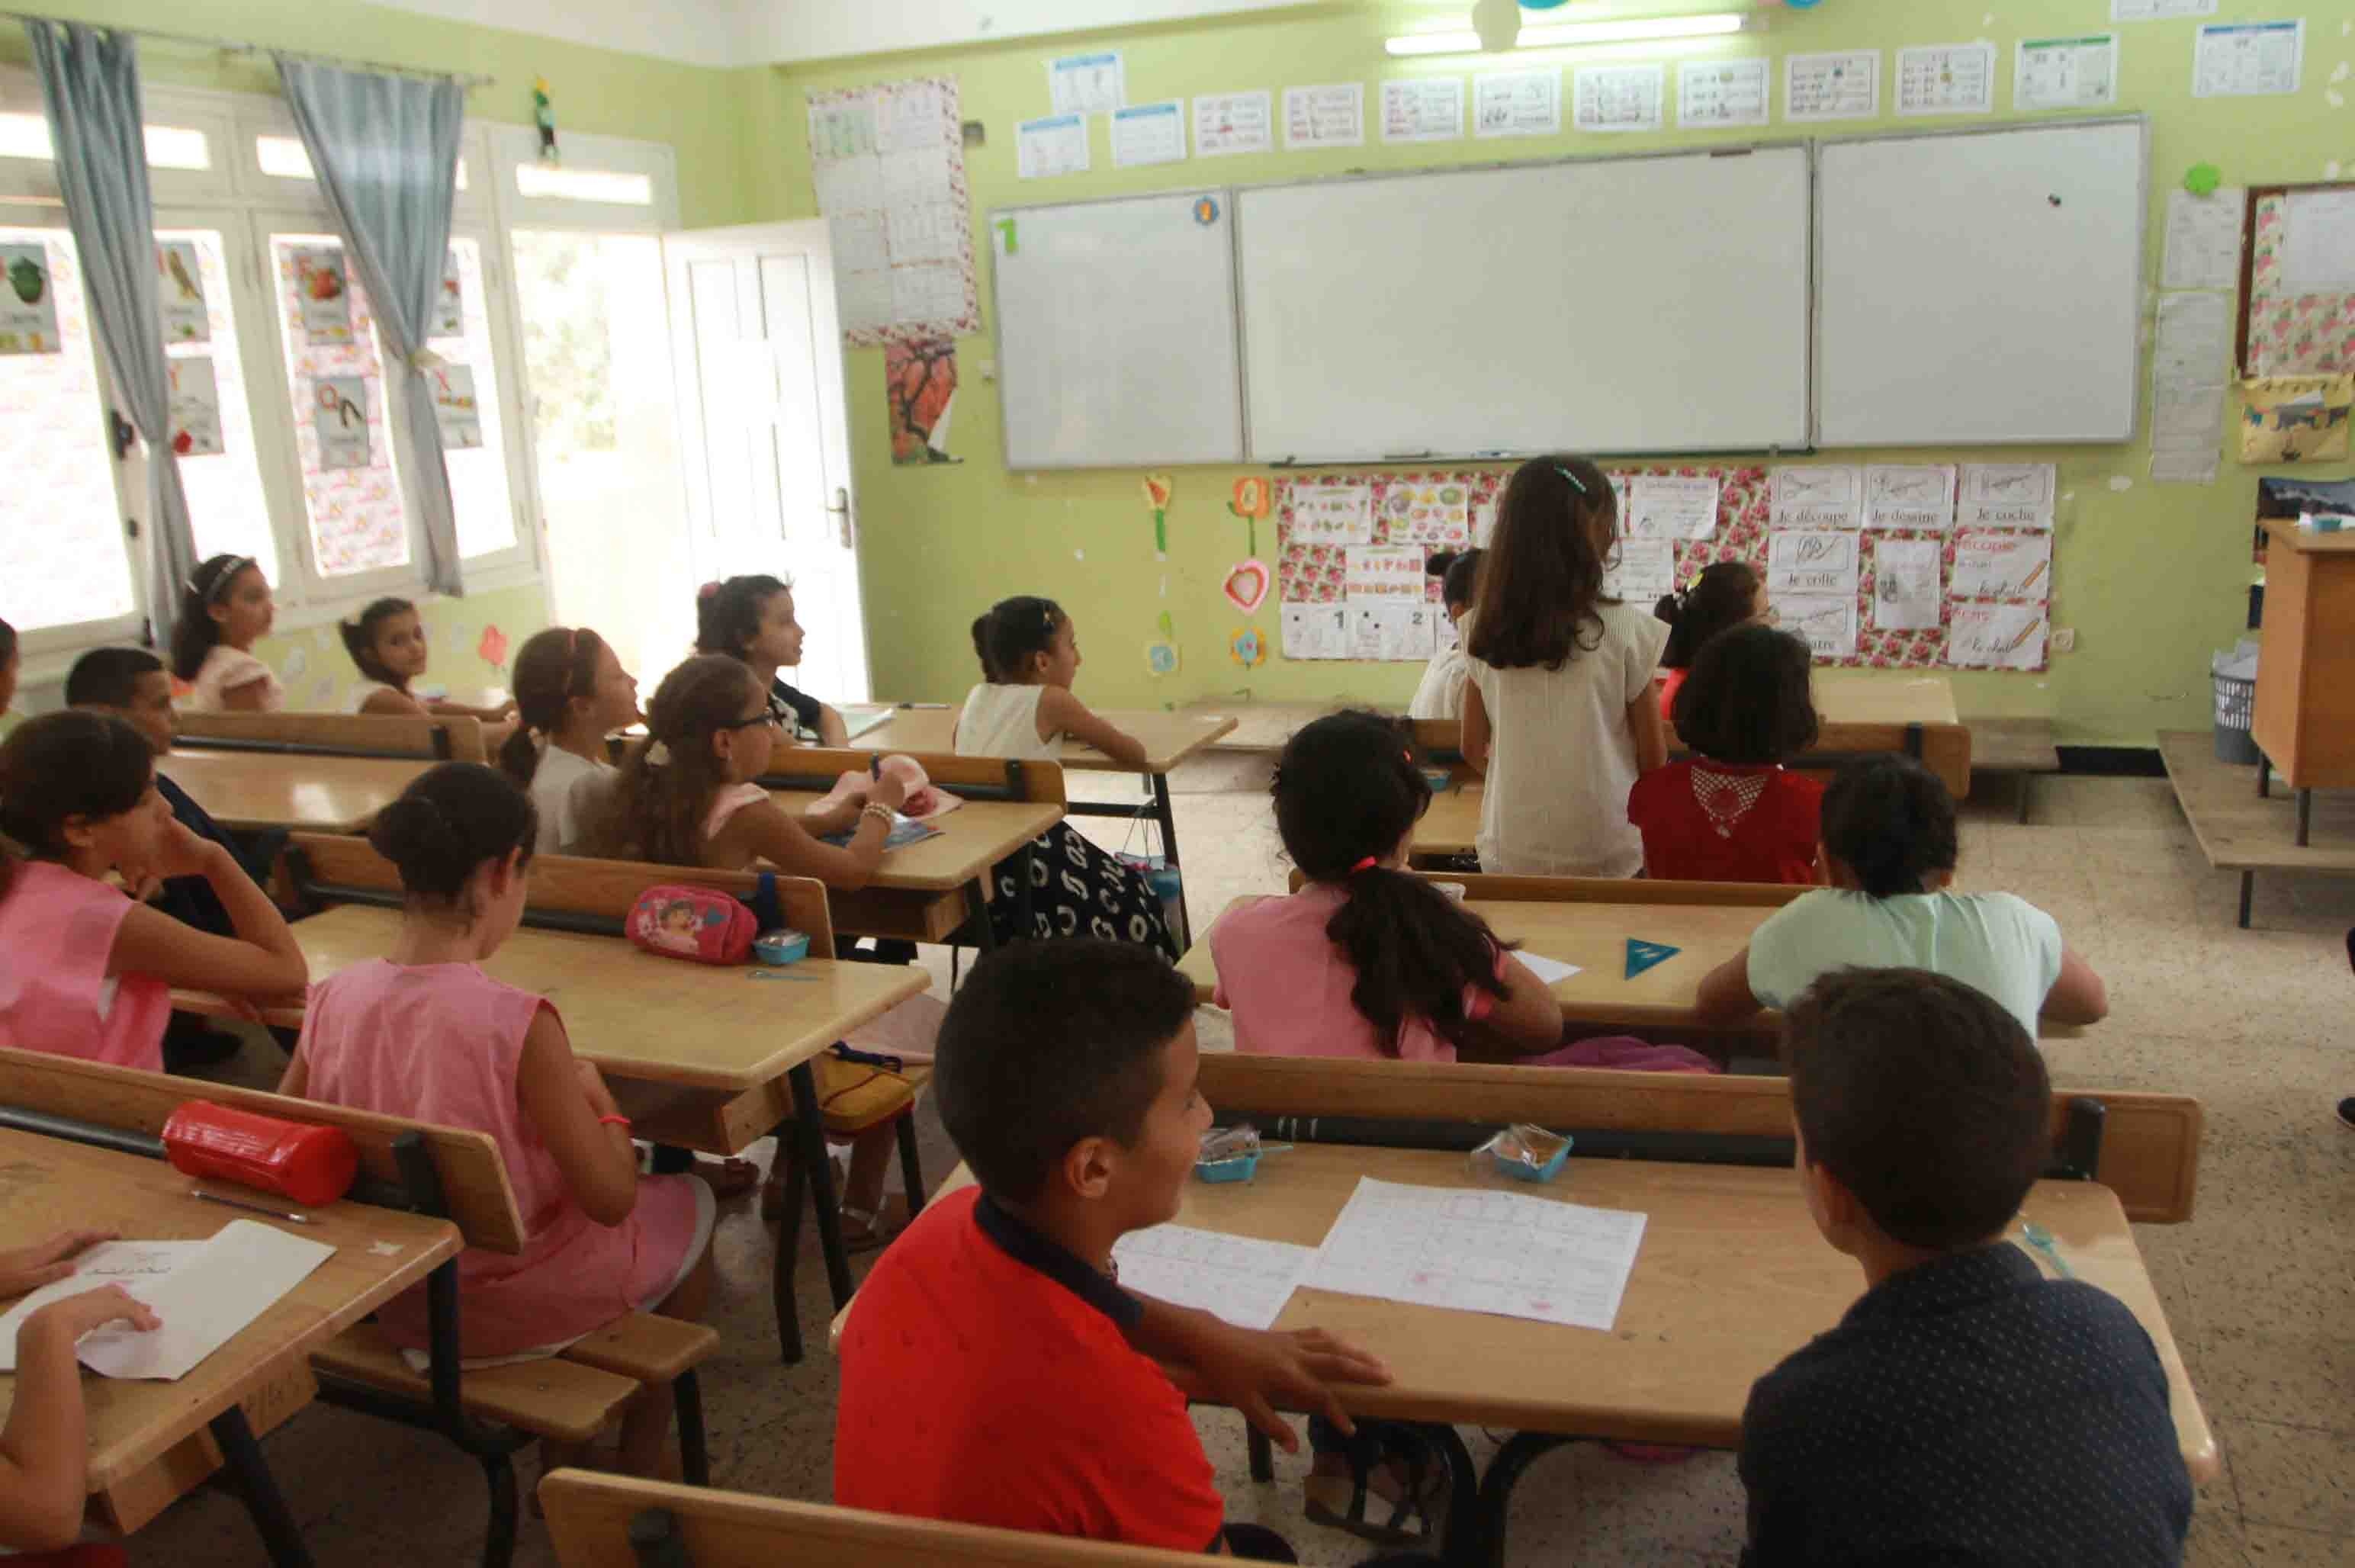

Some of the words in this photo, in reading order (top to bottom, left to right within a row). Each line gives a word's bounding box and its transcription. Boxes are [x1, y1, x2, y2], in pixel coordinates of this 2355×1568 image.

[1777, 509, 1792, 524] Je
[1796, 507, 1849, 525] découpe
[1872, 508, 1886, 522] Je
[1976, 506, 1990, 521] Je
[1335, 610, 1344, 628] 1
[1412, 612, 1423, 625] 2
